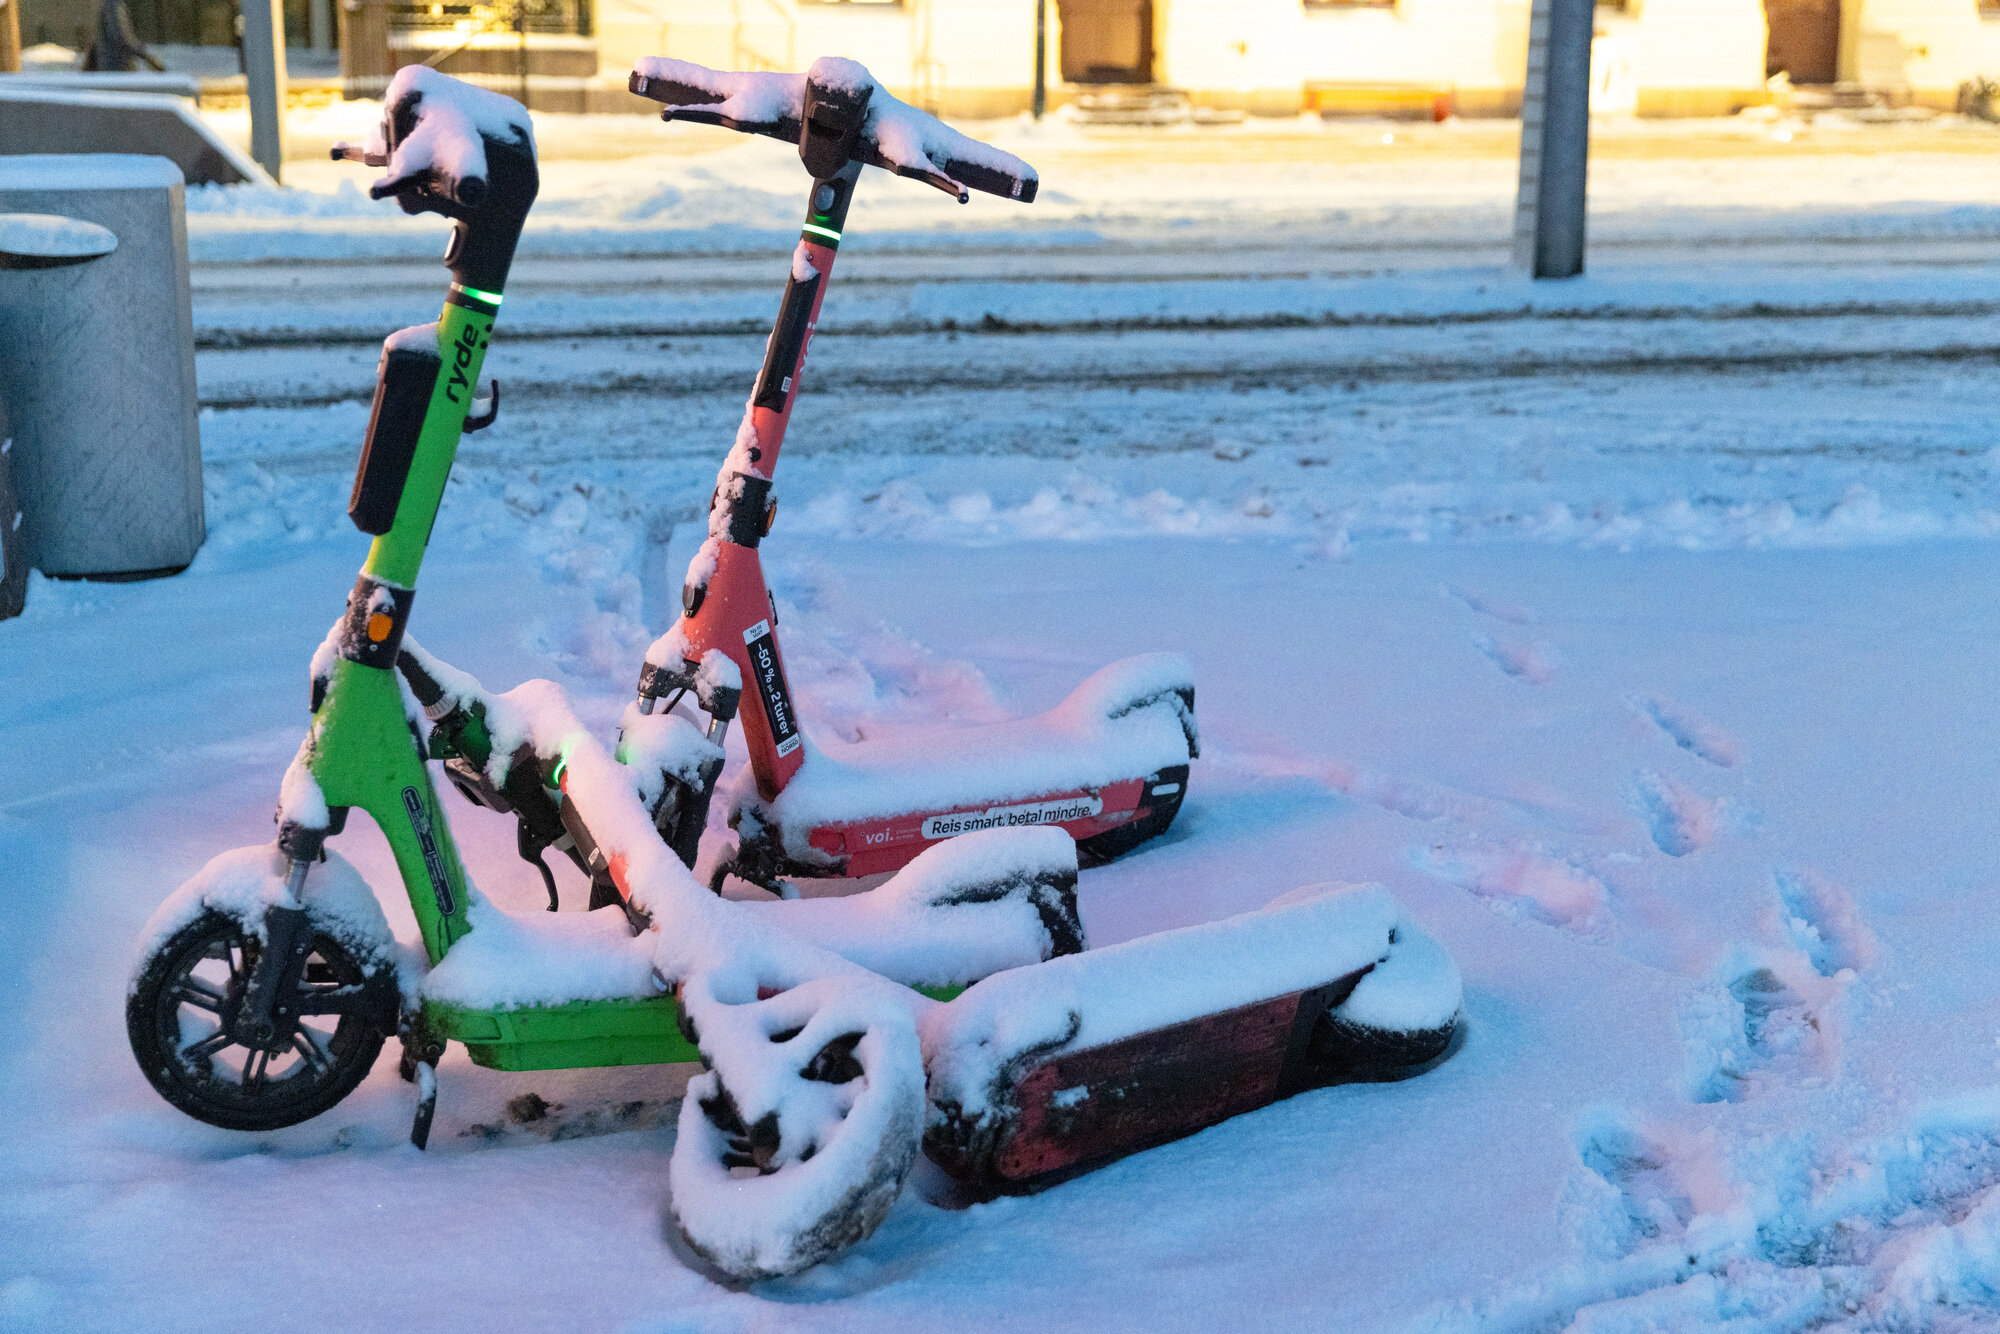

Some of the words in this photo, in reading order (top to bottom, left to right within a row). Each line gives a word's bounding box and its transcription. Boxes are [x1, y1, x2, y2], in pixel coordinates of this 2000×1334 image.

[446, 324, 479, 404] ryde
[770, 691, 781, 703] 2
[774, 701, 789, 734] turer
[932, 819, 961, 835] Reis
[1008, 809, 1042, 826] betal
[1044, 803, 1092, 821] mindre.
